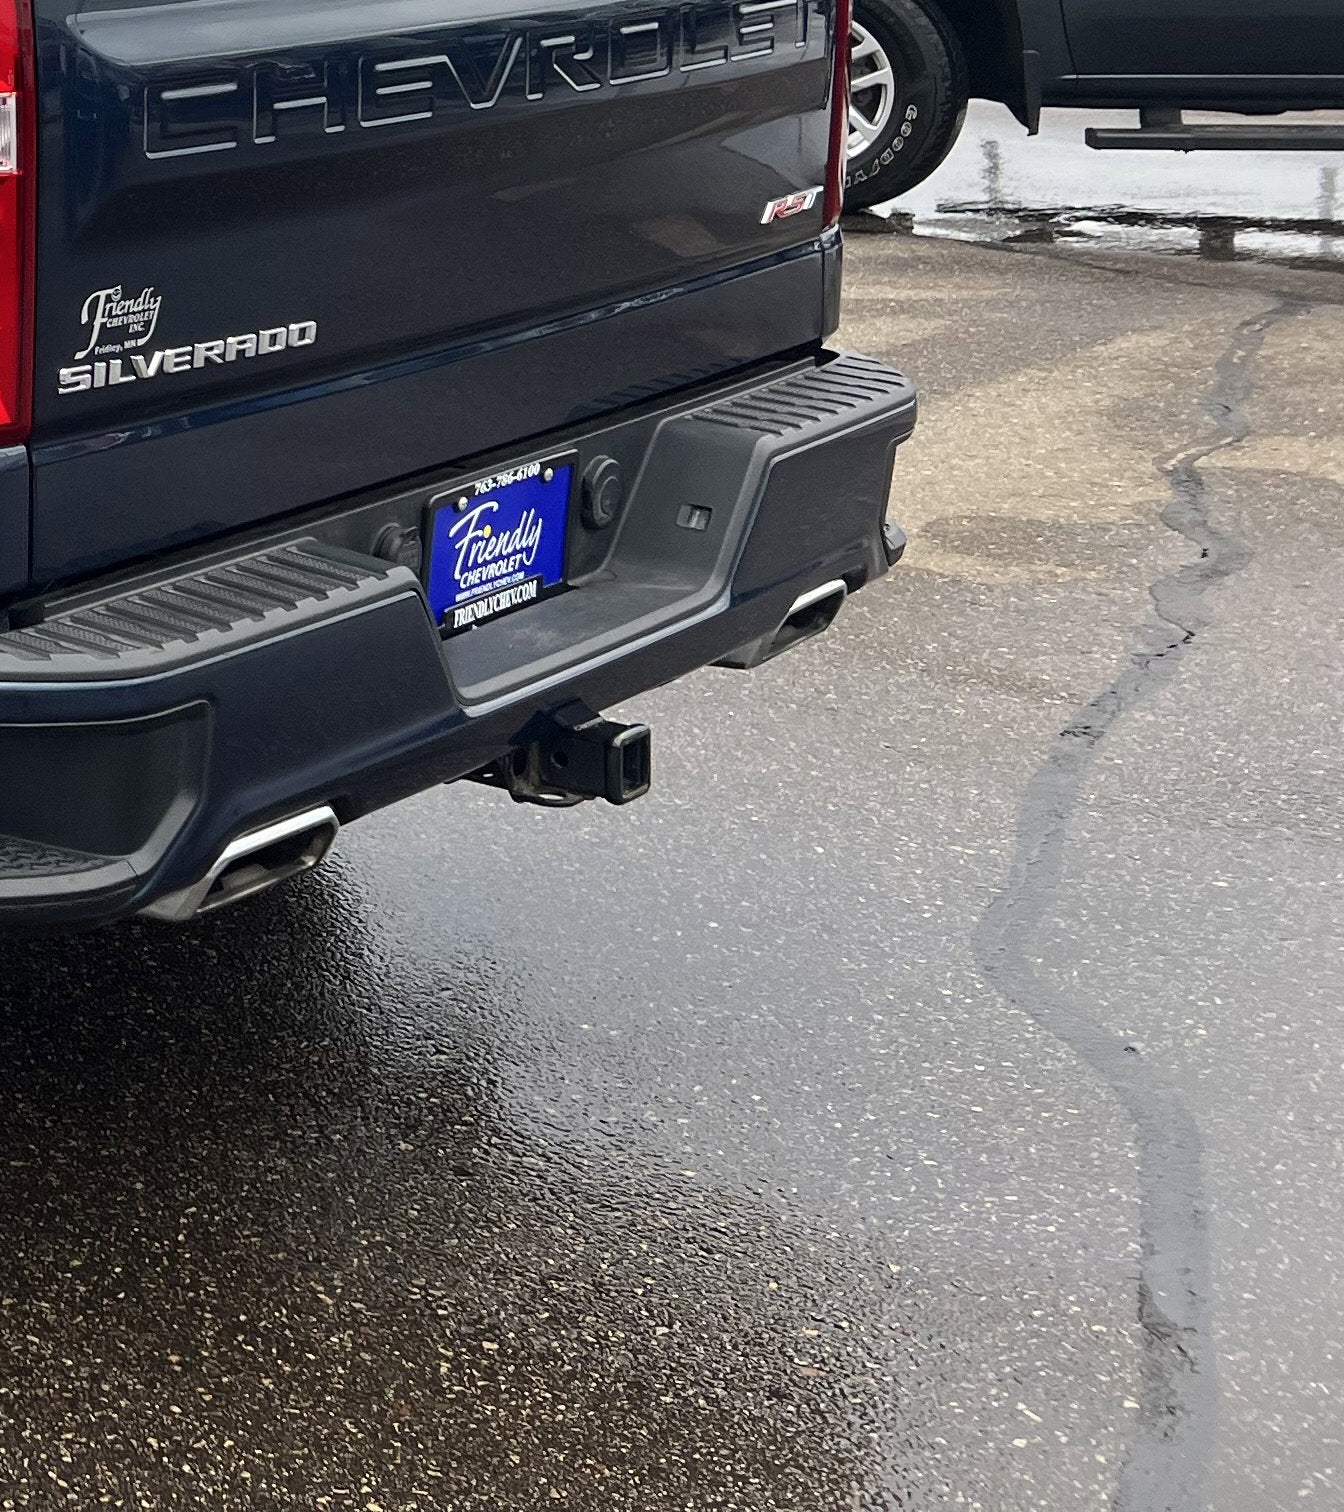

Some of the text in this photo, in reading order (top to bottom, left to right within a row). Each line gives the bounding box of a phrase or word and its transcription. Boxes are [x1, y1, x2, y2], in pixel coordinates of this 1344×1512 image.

[845, 104, 918, 188] GOODY
[760, 186, 824, 225] RST
[74, 285, 162, 360] Friendly
[106, 310, 155, 328] CHEVROLET
[58, 320, 317, 395] SILVERADO
[475, 462, 541, 495] 763-786-6100
[448, 501, 543, 580] Friendly
[459, 554, 523, 589] CHEVROLET
[453, 579, 538, 628] FRIENDLYCHEV.COM
